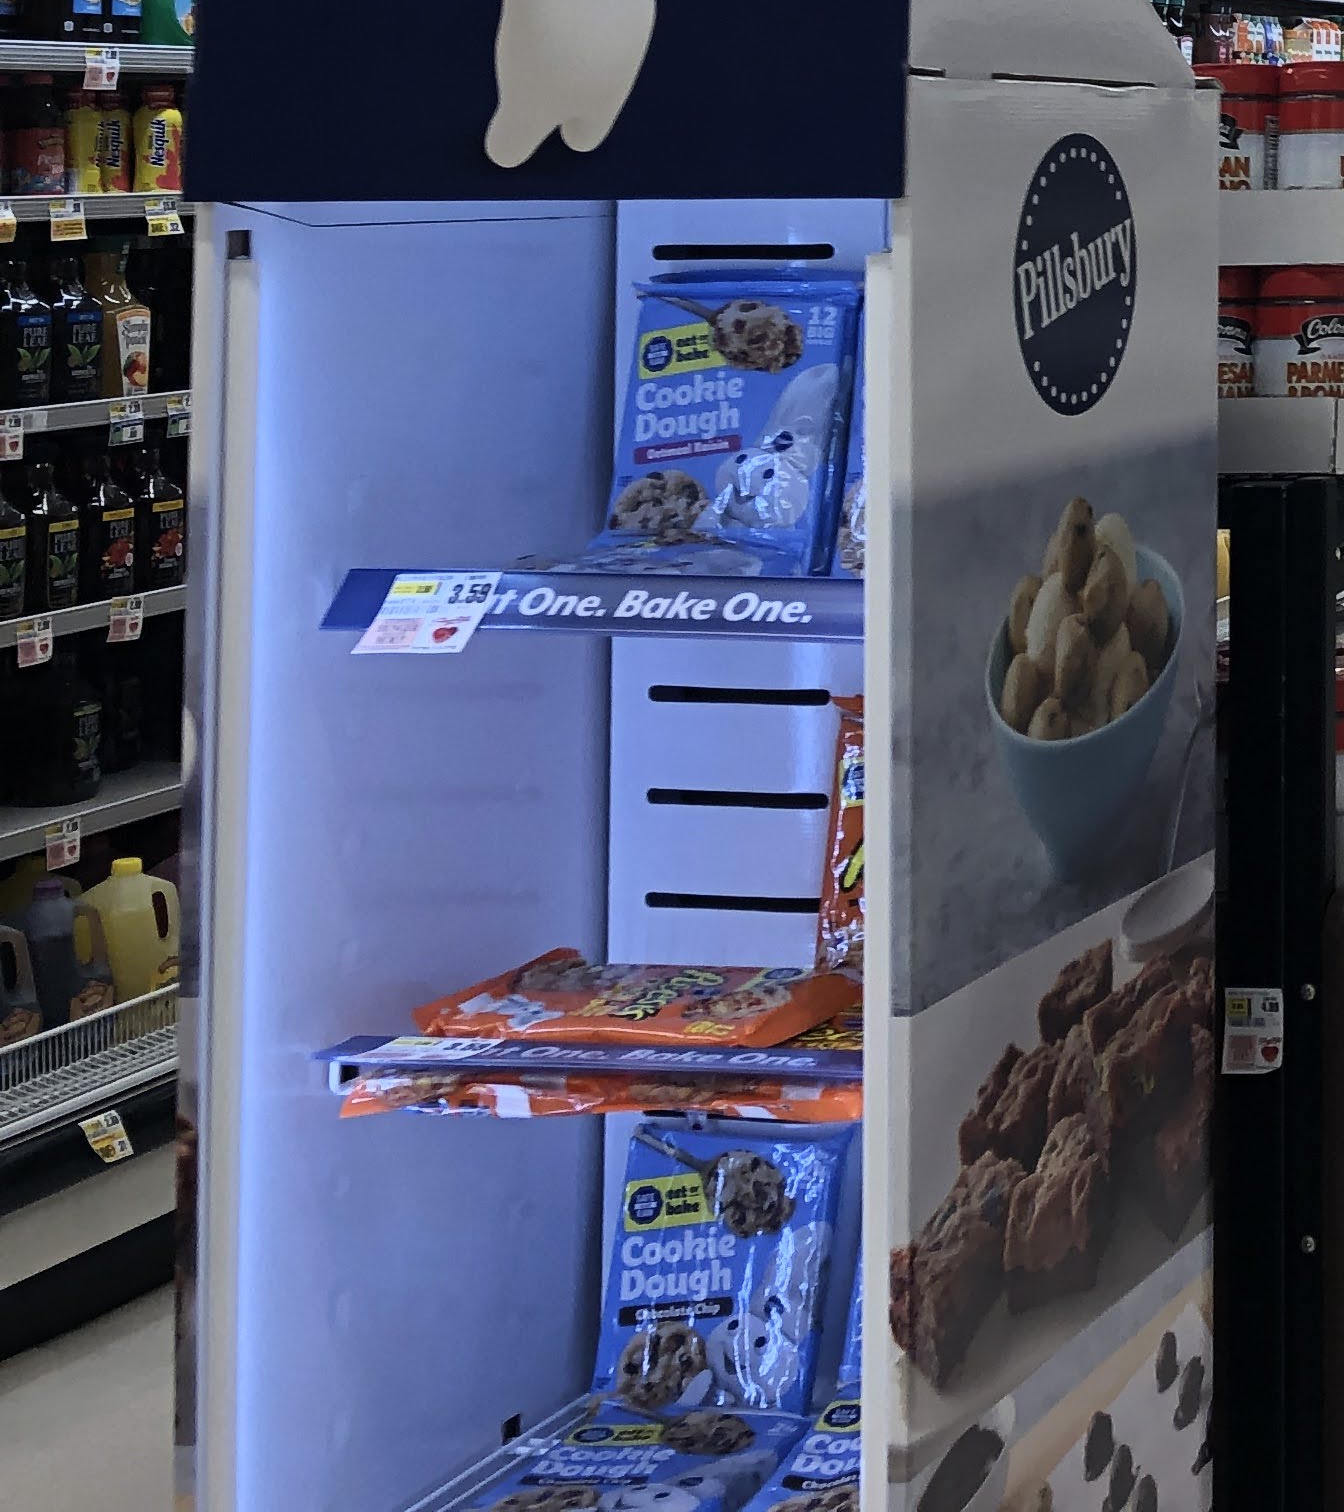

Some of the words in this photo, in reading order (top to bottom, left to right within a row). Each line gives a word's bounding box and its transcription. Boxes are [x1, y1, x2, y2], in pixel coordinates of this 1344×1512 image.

[106, 120, 121, 168] Nesquik
[150, 118, 167, 166] Nesquik
[1017, 219, 1133, 340] Pillsbury
[808, 306, 837, 325] 12
[807, 326, 834, 338] BIG
[635, 371, 744, 411] Cookie
[635, 401, 739, 442] Dough
[448, 582, 494, 605] 3.59
[518, 587, 607, 617] One.
[614, 589, 716, 620] Bake
[723, 592, 813, 624] One.
[508, 1045, 608, 1062] One.
[617, 1049, 720, 1066] Bake
[727, 1052, 816, 1069] One.
[665, 1187, 687, 1200] eat
[665, 1200, 700, 1216] bake
[621, 1226, 736, 1266] Cookie
[620, 1259, 731, 1301] Dough
[694, 1301, 721, 1317] Chip
[550, 1446, 677, 1462] Cookie
[803, 1434, 861, 1454] Coo
[532, 1460, 660, 1478] Dough
[790, 1454, 861, 1474] Dou
